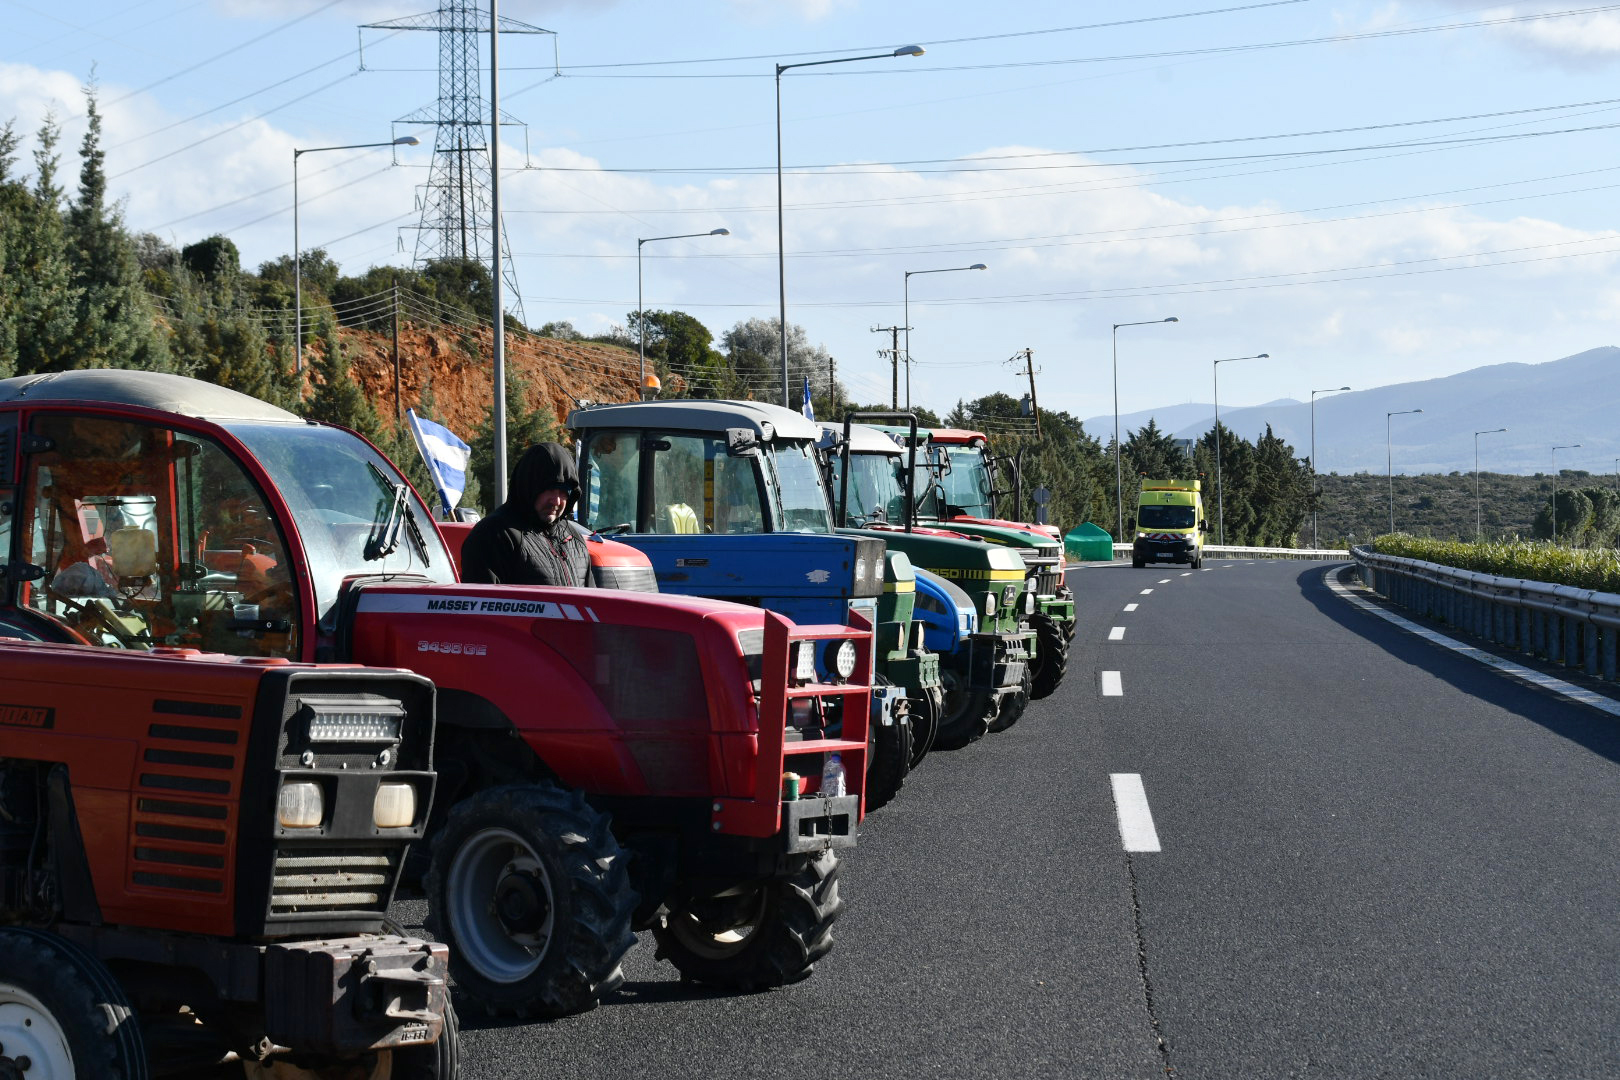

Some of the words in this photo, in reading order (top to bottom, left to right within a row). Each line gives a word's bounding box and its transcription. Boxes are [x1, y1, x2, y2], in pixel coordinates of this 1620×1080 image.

[427, 599, 478, 611] MASSEY
[480, 601, 546, 614] FERGUSON
[463, 643, 488, 656] GE
